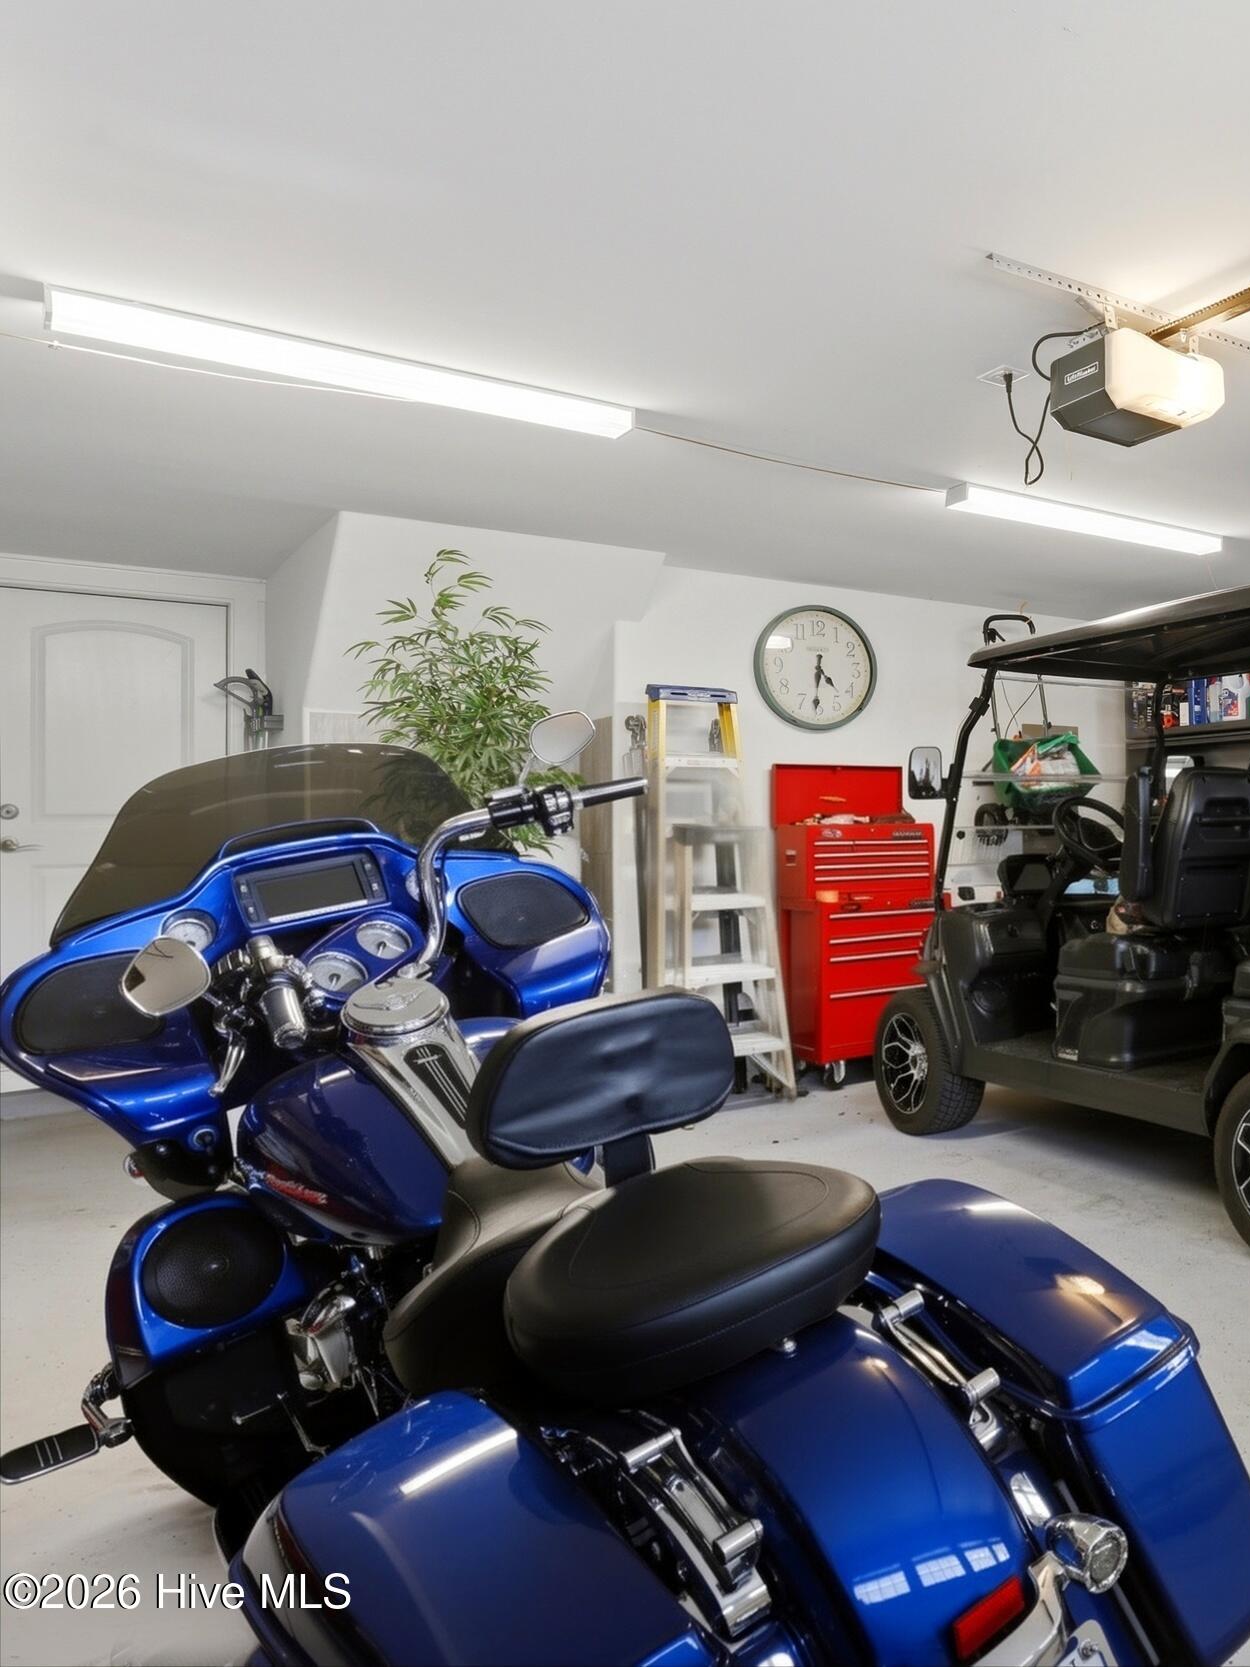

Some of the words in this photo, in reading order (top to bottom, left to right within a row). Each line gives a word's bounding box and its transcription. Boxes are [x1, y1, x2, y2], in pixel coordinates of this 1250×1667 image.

[794, 623, 806, 641] 11
[810, 620, 826, 638] 12
[833, 626, 839, 645] 1
[846, 642, 855, 657] 2
[773, 656, 784, 674] 9
[852, 662, 861, 680] 3
[779, 677, 790, 696] 8
[845, 682, 854, 699] 4
[797, 693, 808, 711] 7
[832, 695, 842, 713] 5
